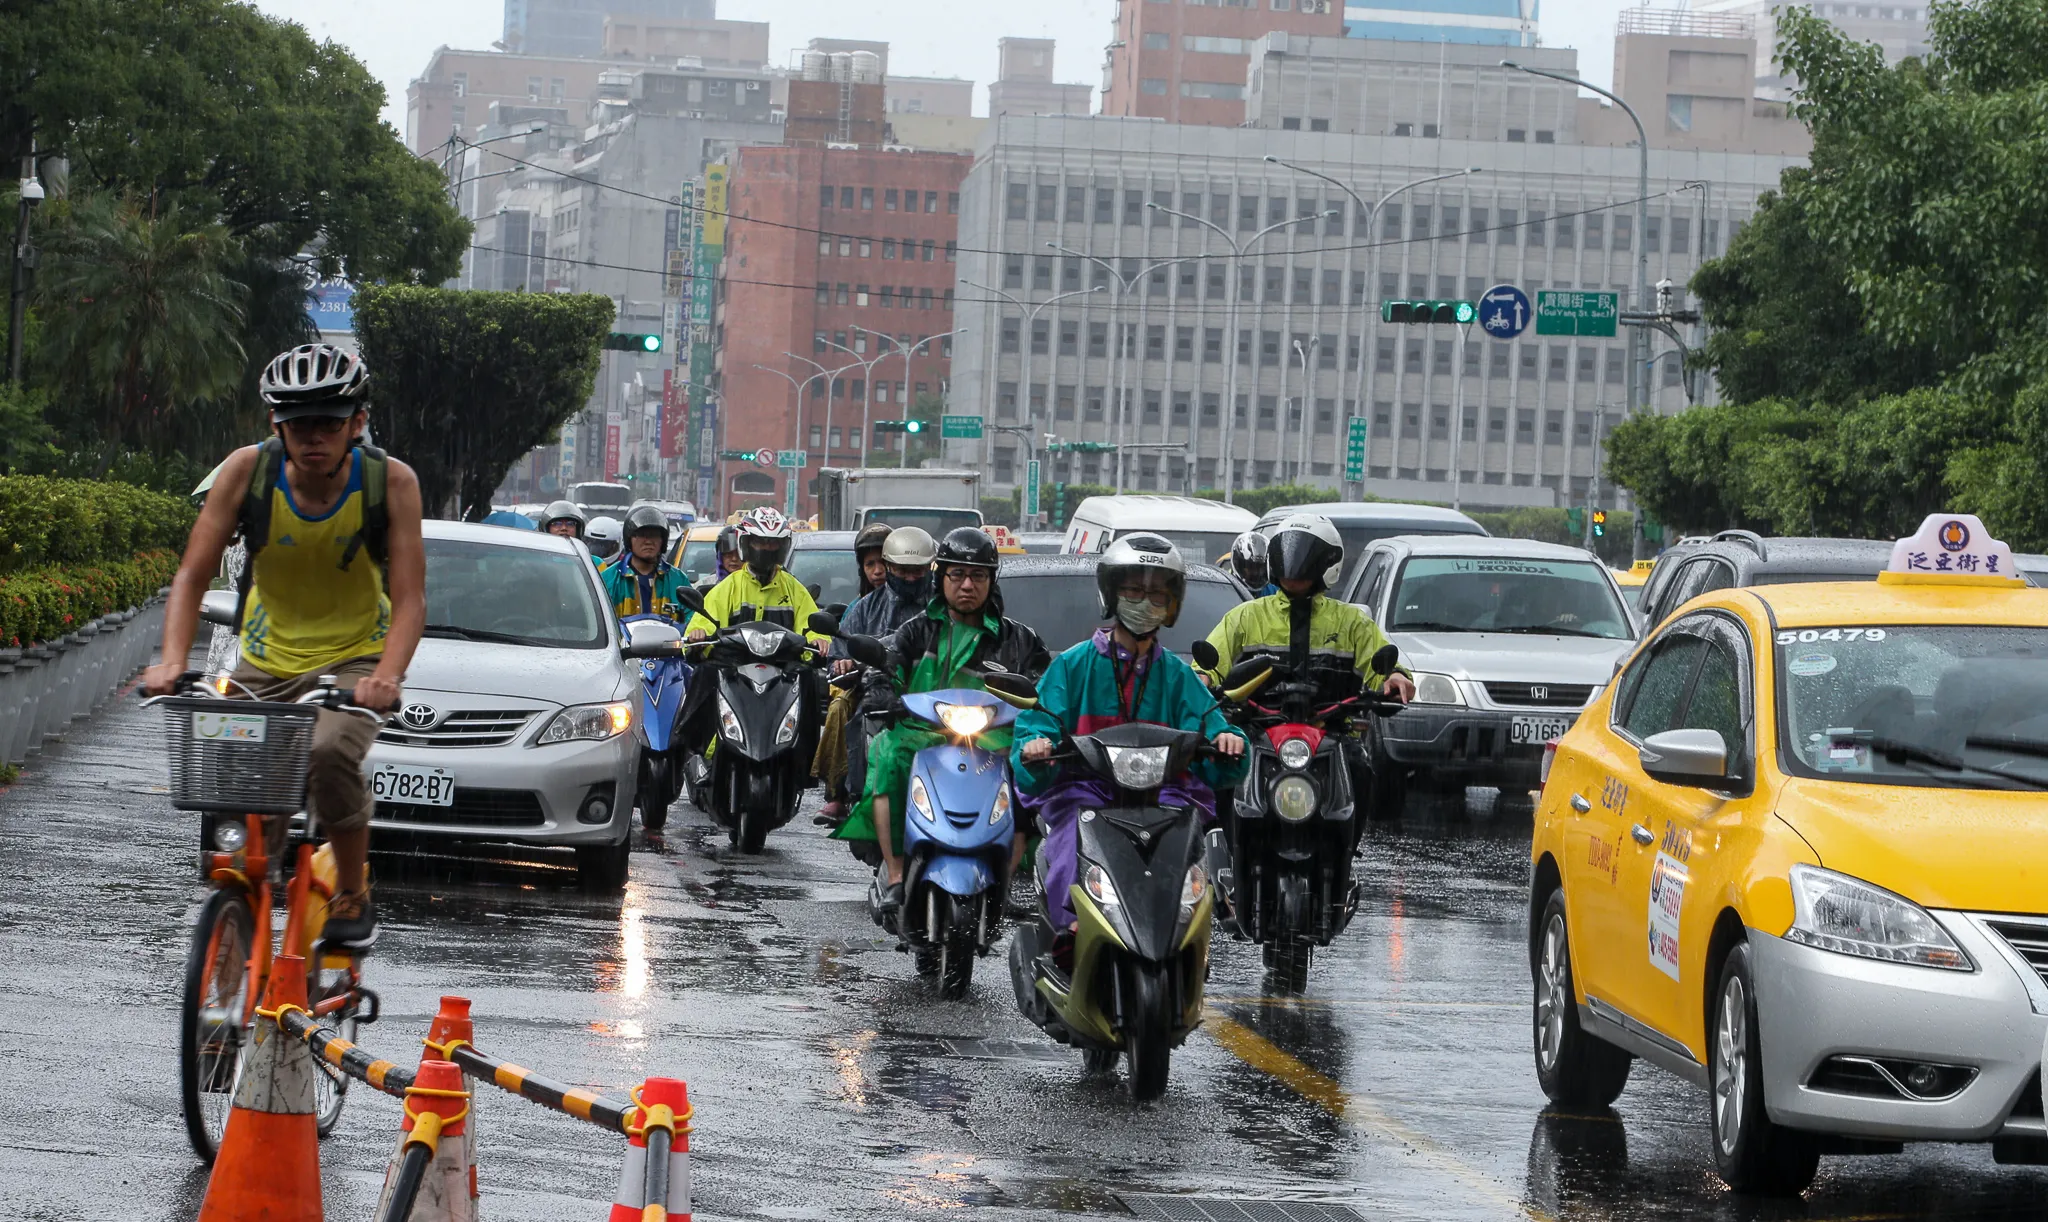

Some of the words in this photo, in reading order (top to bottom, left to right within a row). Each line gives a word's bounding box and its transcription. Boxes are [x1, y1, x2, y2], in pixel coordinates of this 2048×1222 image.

[1544, 293, 1611, 309] 貴陽街一段
[1139, 555, 1165, 565] SUPA
[1907, 551, 1999, 573] 泛亞衛星
[1477, 565, 1555, 575] HONDA
[1776, 628, 1887, 645] 50479
[372, 771, 454, 801] 6782-B7
